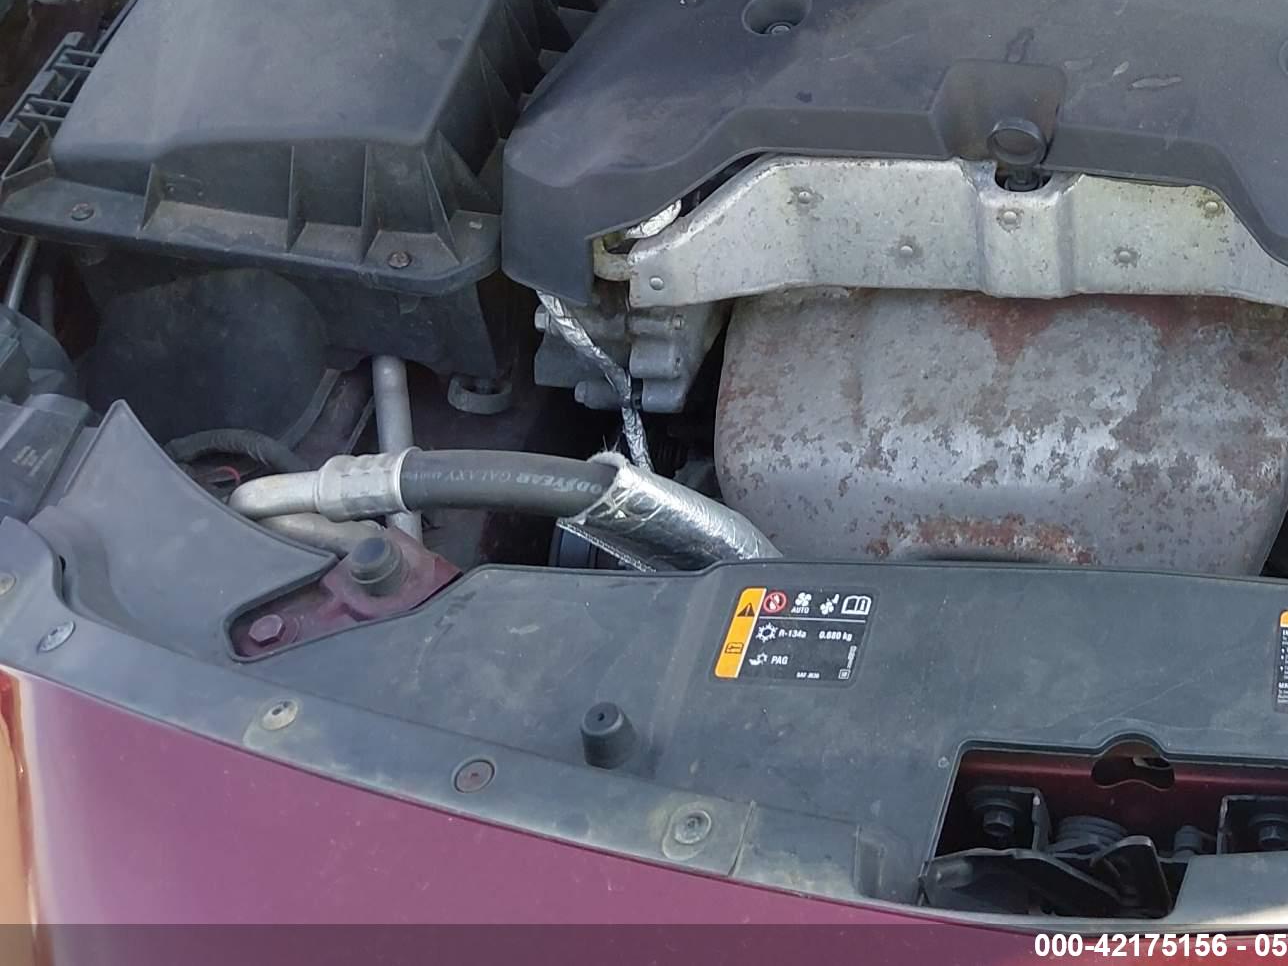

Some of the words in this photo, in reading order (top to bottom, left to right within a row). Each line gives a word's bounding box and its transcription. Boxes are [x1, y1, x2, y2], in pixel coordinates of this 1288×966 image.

[790, 606, 810, 614] AUTO
[778, 628, 807, 639] R-134a
[842, 631, 853, 642] kg
[770, 655, 789, 665] PAG
